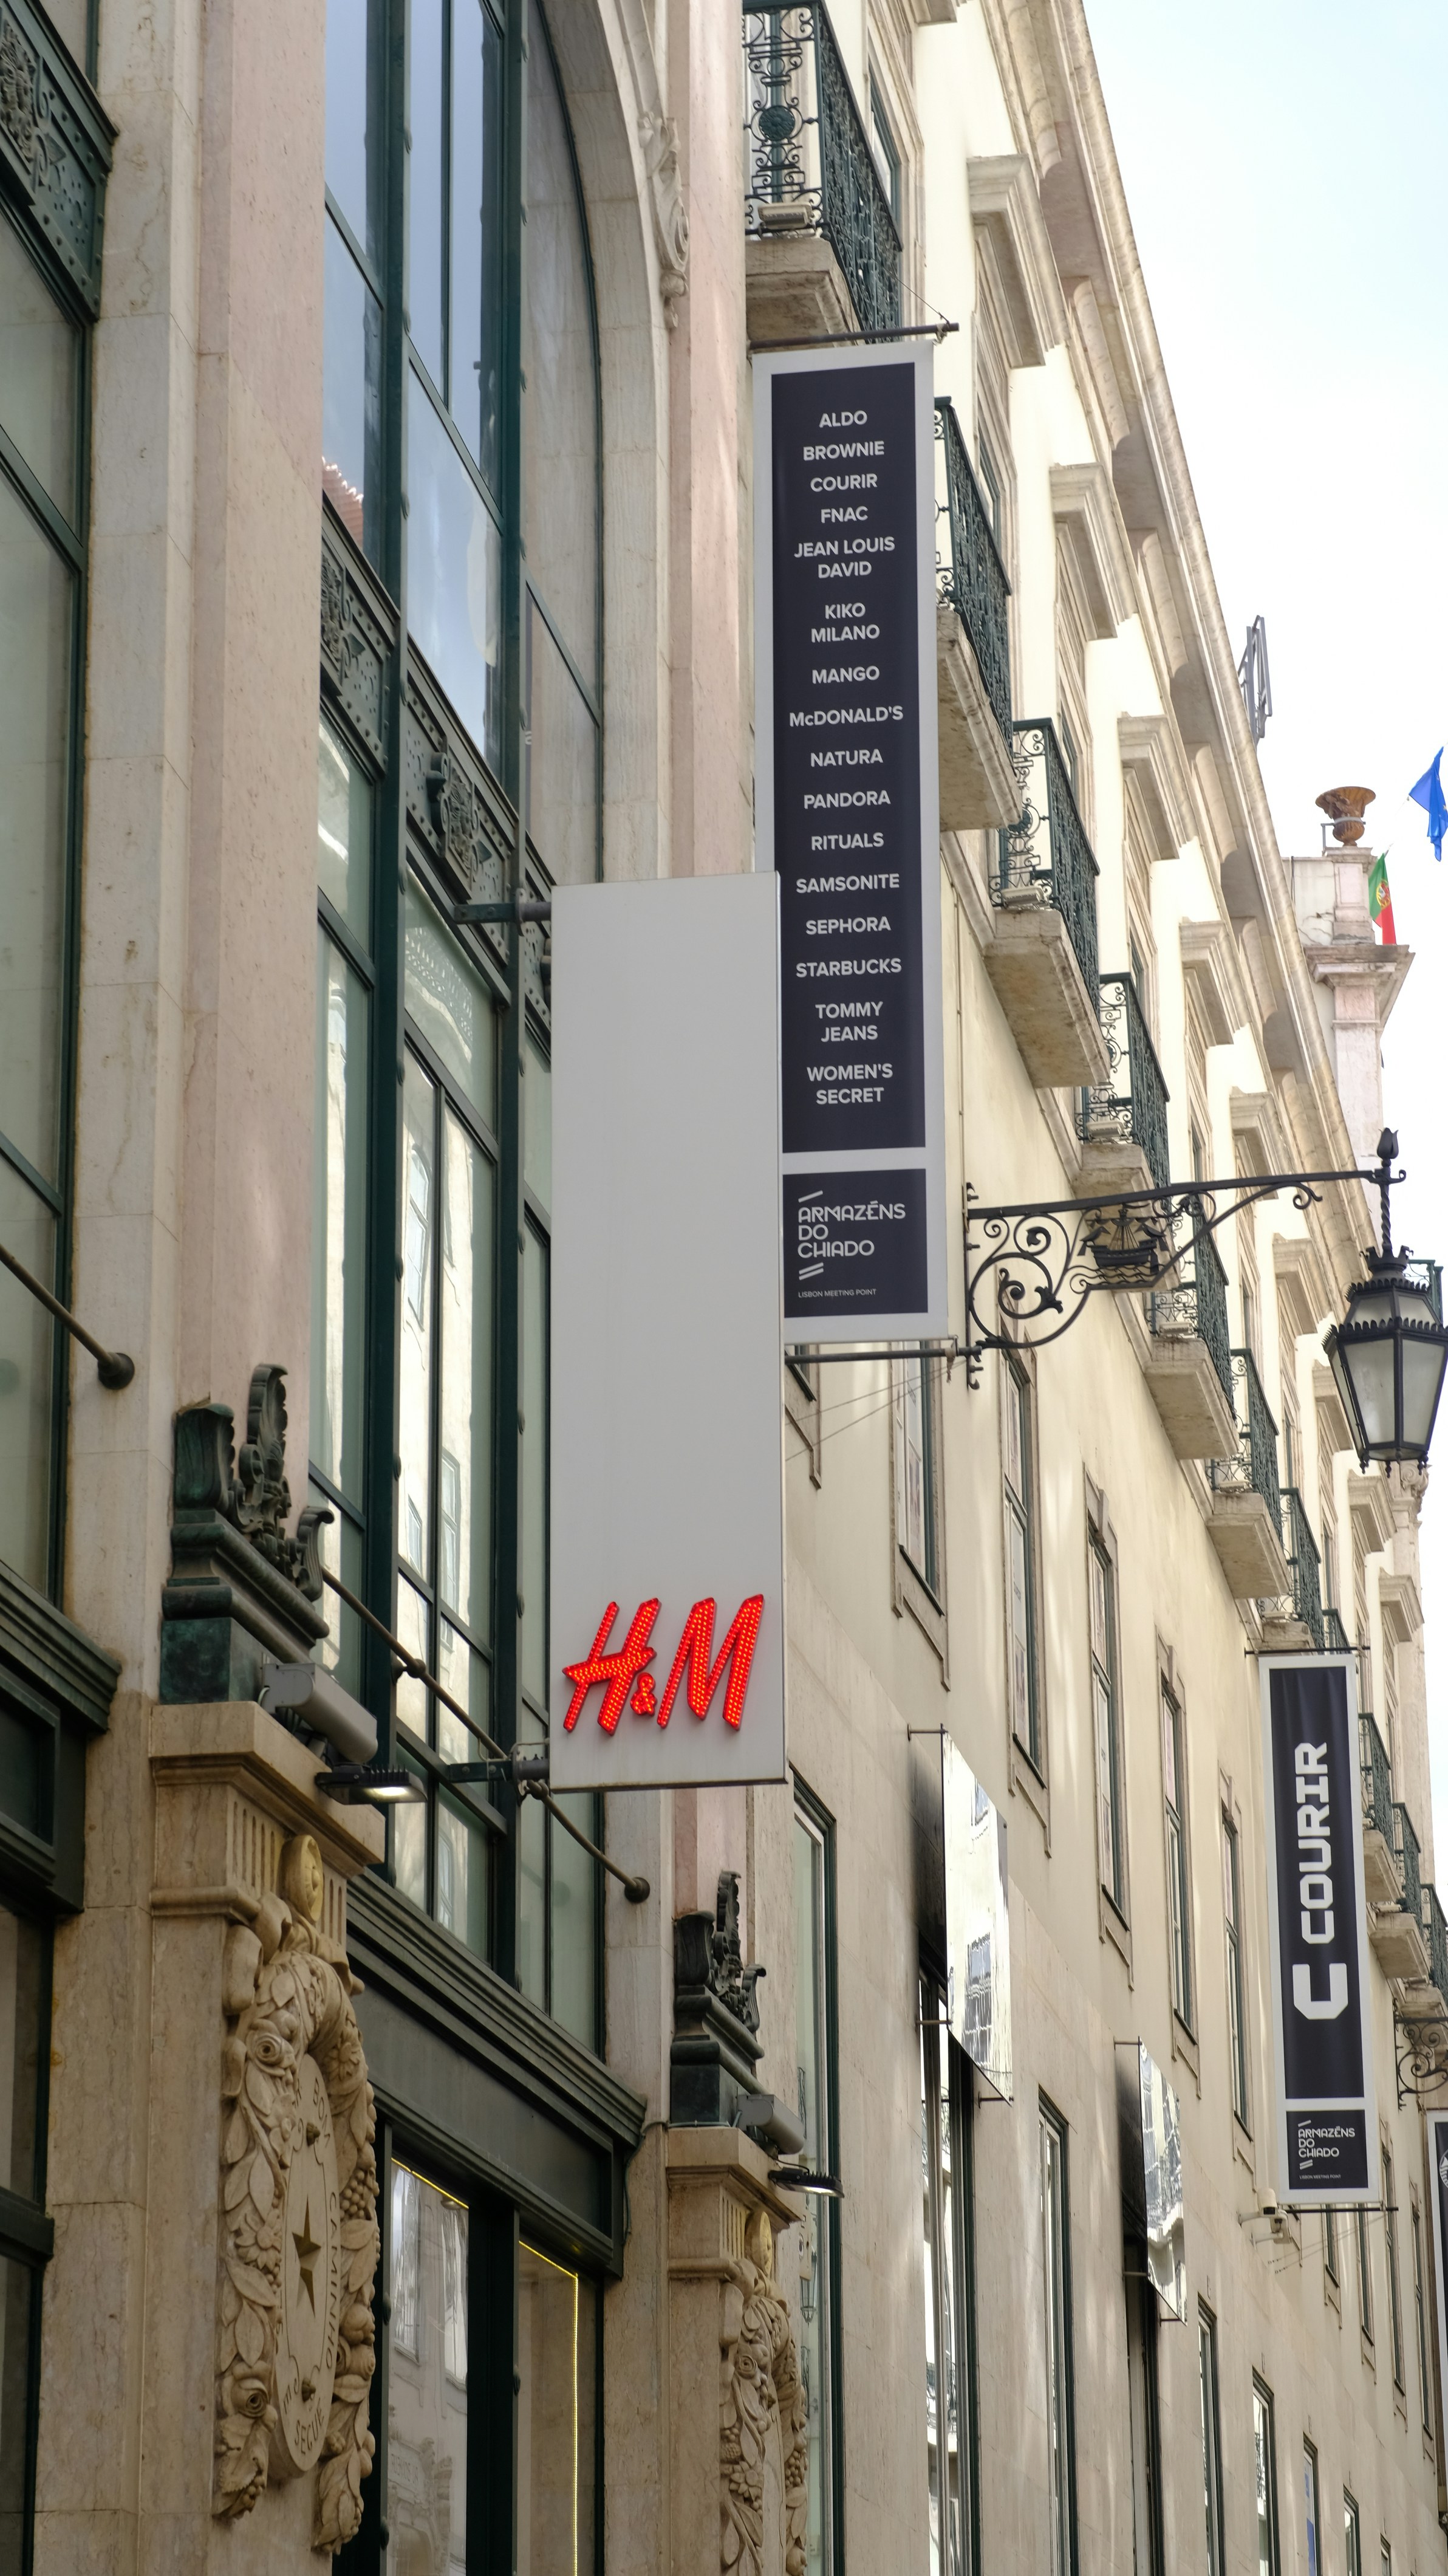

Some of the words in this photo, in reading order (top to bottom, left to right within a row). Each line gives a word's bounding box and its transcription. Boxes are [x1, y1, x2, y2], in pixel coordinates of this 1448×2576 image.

[819, 410, 868, 428] ALDO
[803, 440, 884, 461] BROWNIE
[810, 473, 878, 492] COURIR
[821, 505, 868, 524] FNAC
[794, 540, 839, 558] JEAN
[844, 536, 895, 554] LOUIS
[818, 561, 872, 579] DAVID
[825, 602, 866, 619] KIKO
[811, 624, 880, 643] MILANO
[812, 665, 880, 684] MANGO
[790, 705, 904, 727] McDONALD'S
[810, 748, 884, 767] NATURA
[804, 790, 891, 809] PANDORA
[811, 832, 884, 851] RITUALS
[796, 873, 900, 894] SAMSONITE
[805, 916, 891, 935] SEPHORA
[796, 957, 902, 978] STARBUCKS
[814, 1001, 883, 1019] TOMMY
[821, 1025, 878, 1043] JEANS
[807, 1063, 893, 1081] WOMEN'S
[816, 1087, 884, 1105] SECRET
[798, 1200, 906, 1223] ARMAZÉNS
[798, 1224, 829, 1241] DO
[797, 1239, 875, 1259] CHIADO
[562, 1593, 765, 1736] H&M
[1294, 1742, 1336, 1945] COURIR
[1298, 2138, 1315, 2148] DO
[1298, 2147, 1340, 2158] CHIADO
[326, 2191, 339, 2370] CAMINHO
